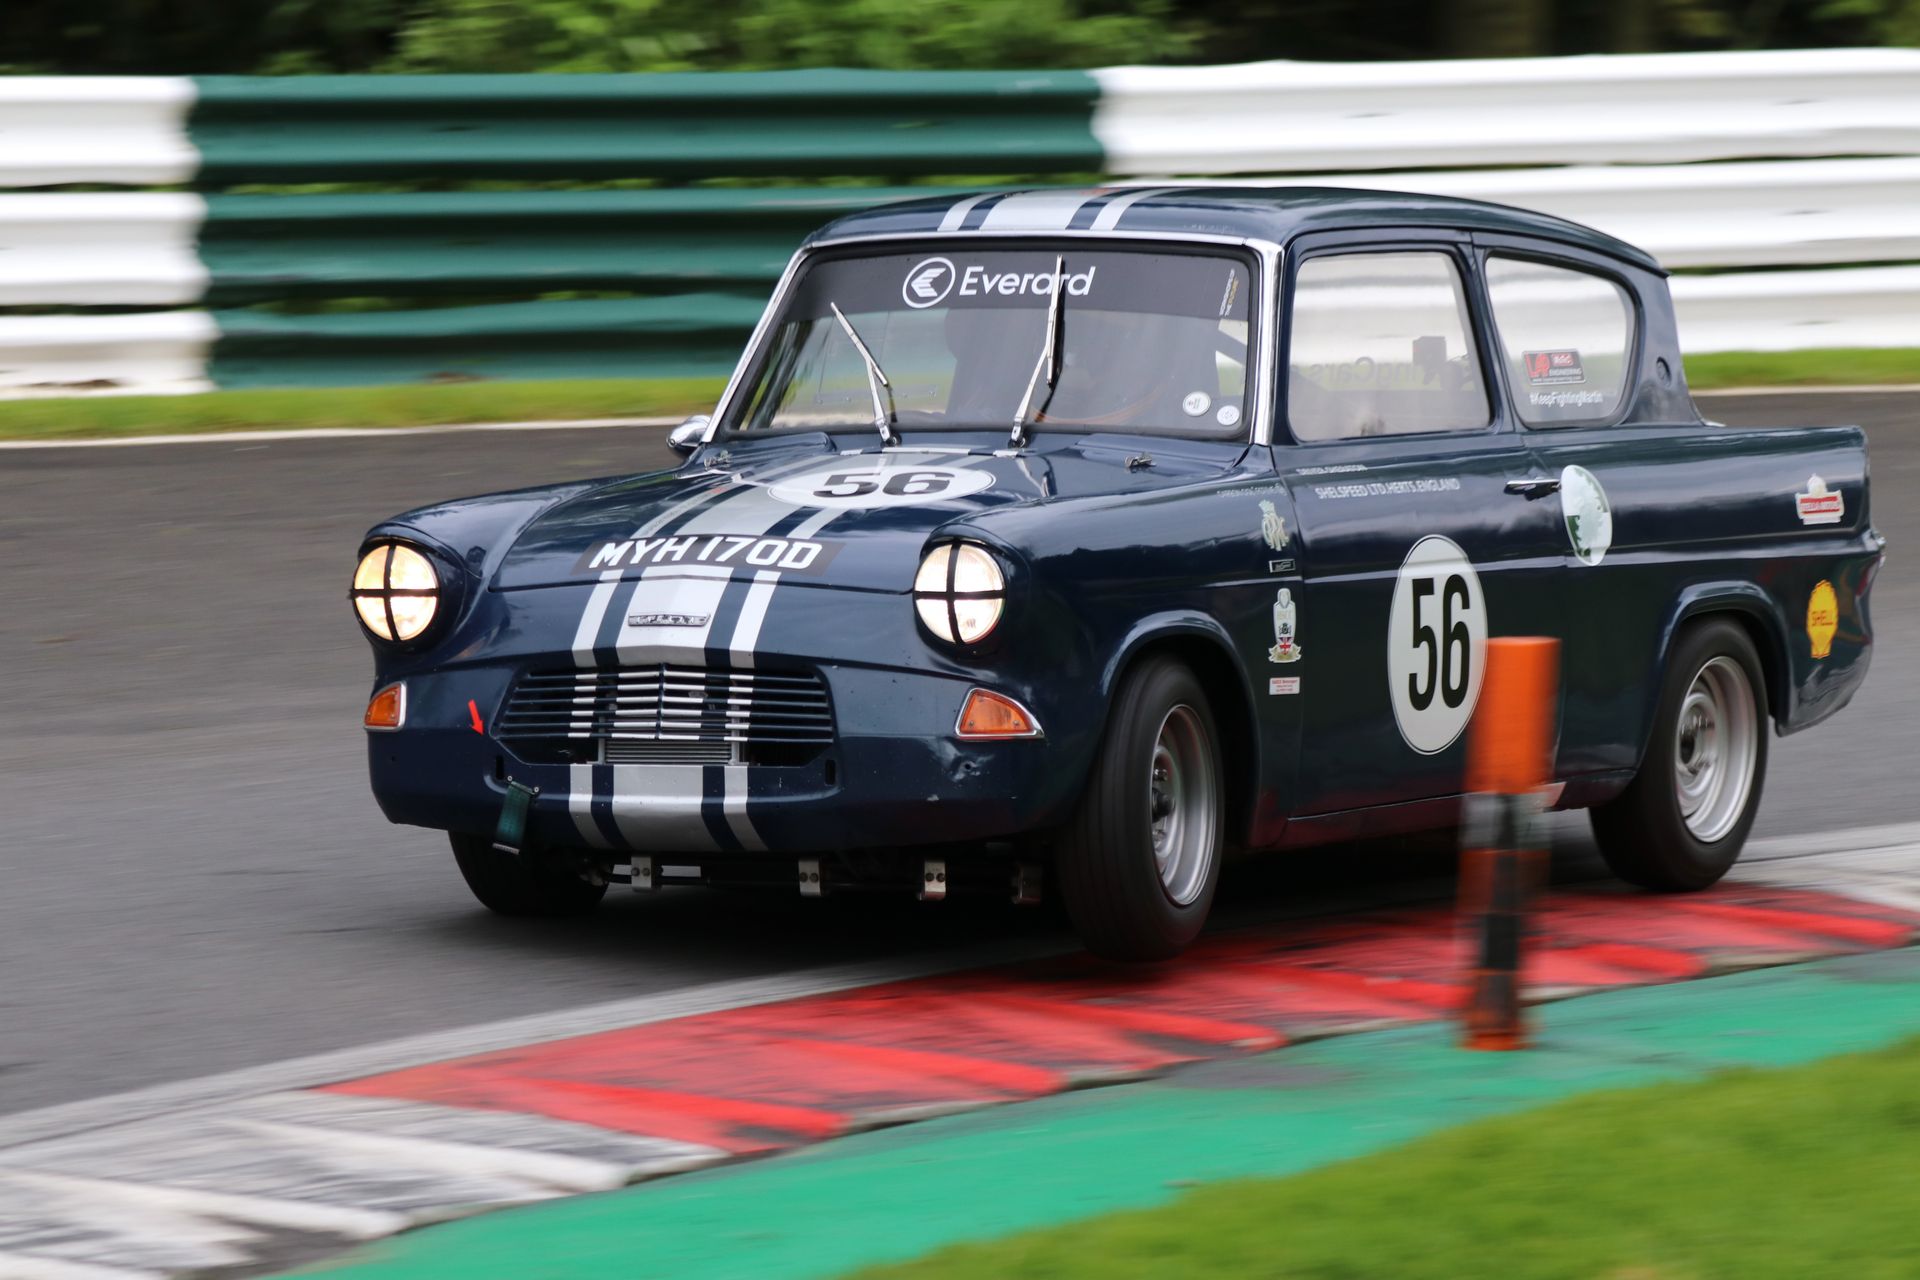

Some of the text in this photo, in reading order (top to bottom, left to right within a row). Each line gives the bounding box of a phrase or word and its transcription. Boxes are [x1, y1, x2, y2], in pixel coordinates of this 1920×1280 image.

[959, 265, 1097, 297] Everard
[812, 472, 956, 498] 56
[1315, 484, 1367, 499] SHELSPEED
[588, 537, 823, 570] MYH 170D
[1408, 573, 1471, 712] 56
